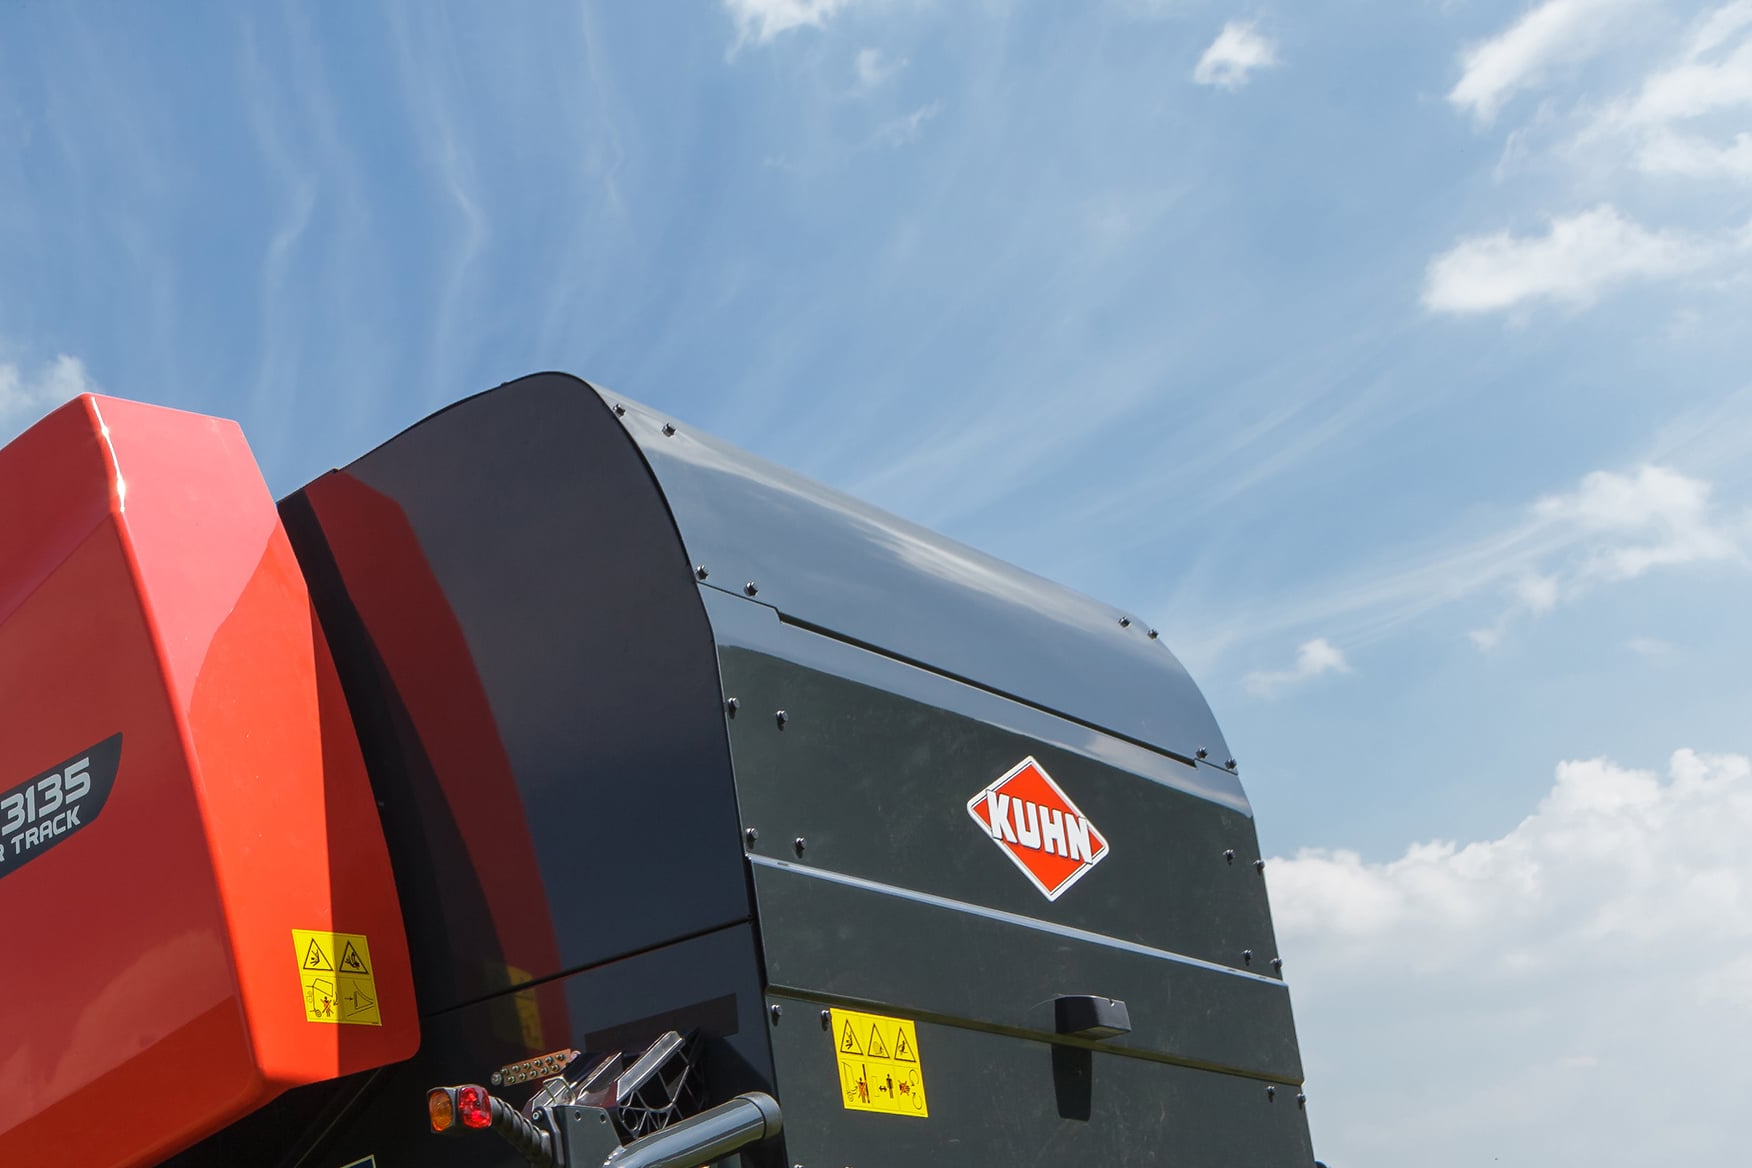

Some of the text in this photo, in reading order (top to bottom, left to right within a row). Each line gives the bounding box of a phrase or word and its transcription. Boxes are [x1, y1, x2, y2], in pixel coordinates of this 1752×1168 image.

[0, 756, 91, 836] 3135
[10, 804, 81, 855] TRACK
[986, 788, 1094, 865] KUHN
